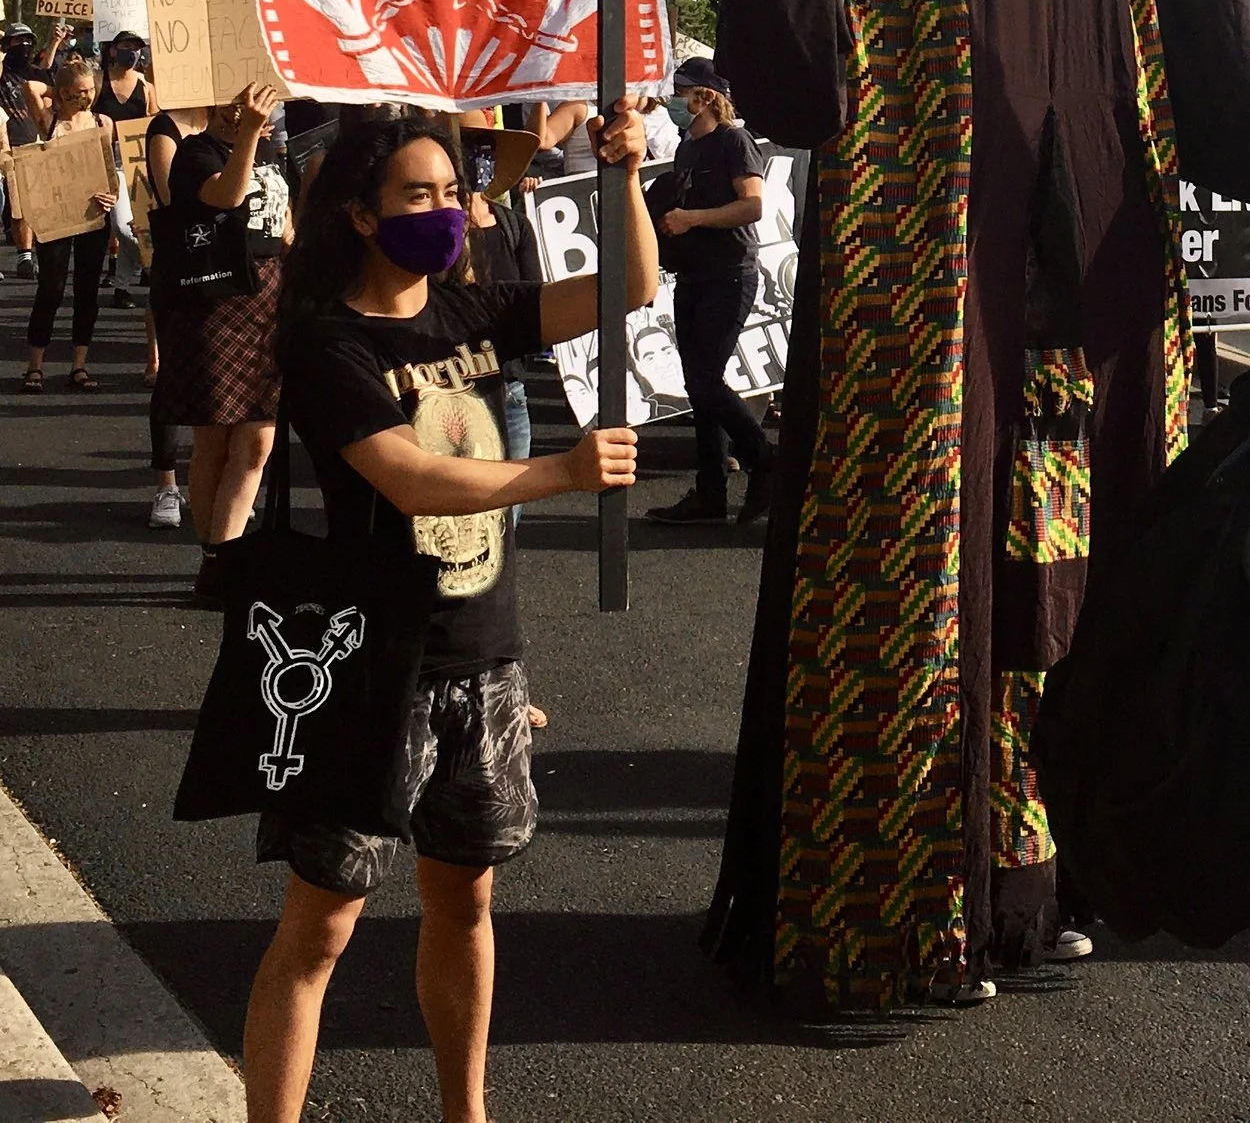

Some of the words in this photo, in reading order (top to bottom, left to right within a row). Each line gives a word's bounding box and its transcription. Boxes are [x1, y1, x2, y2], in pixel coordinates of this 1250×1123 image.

[37, 0, 88, 16] POLICE
[154, 19, 190, 55] NO
[1181, 229, 1220, 263] er
[180, 271, 233, 286] Reformation
